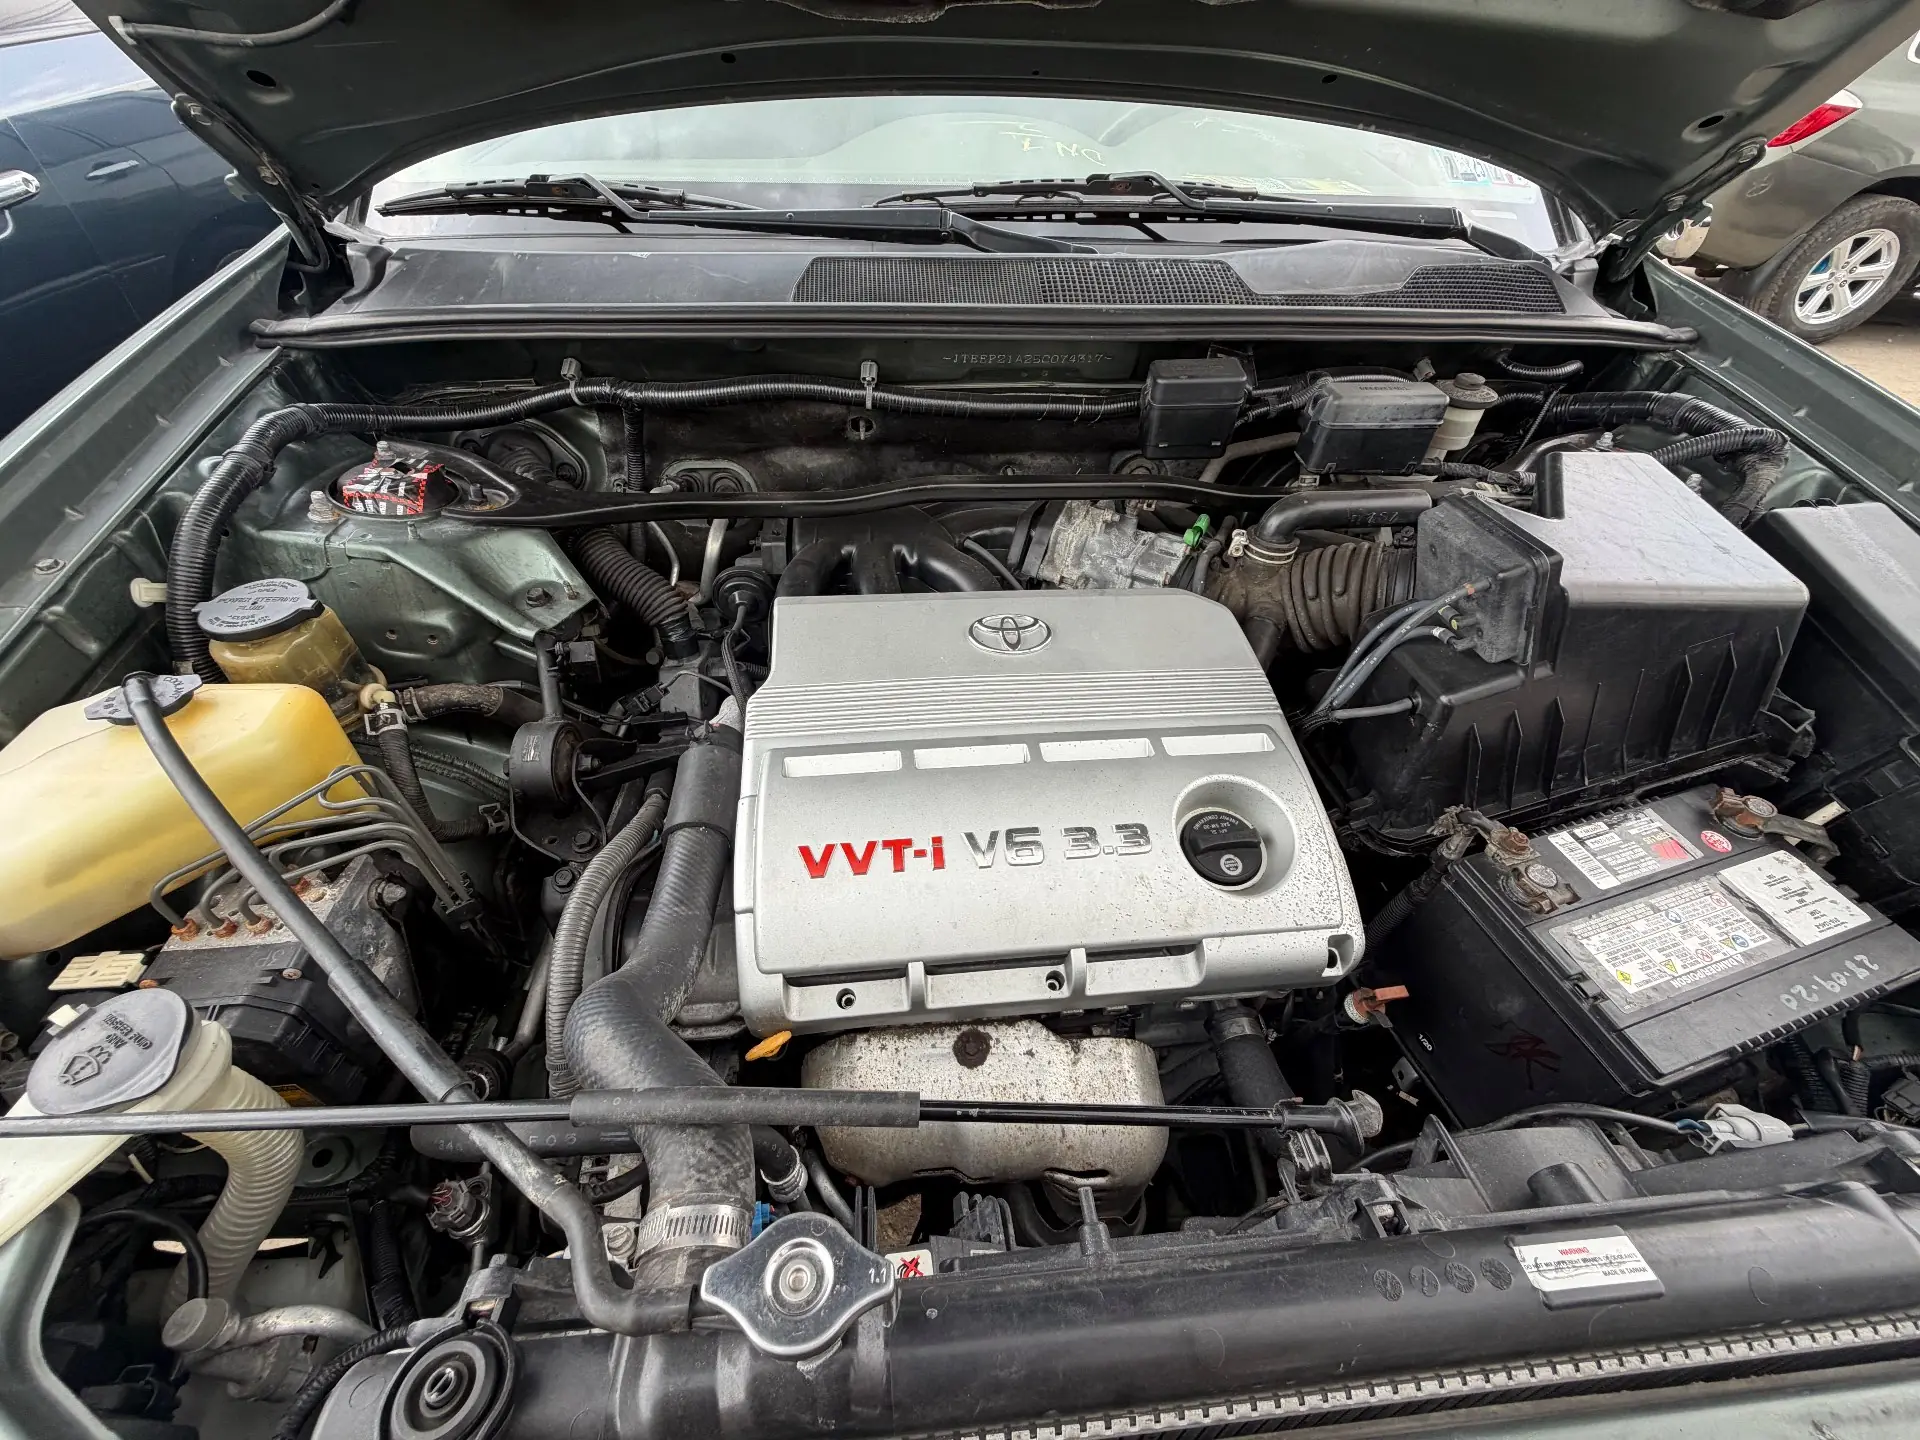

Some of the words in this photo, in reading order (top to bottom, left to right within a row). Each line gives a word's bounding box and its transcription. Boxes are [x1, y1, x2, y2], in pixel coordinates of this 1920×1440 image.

[797, 835, 947, 879] VVT-i
[960, 826, 1045, 870] V6
[1060, 823, 1153, 861] 3.3
[1558, 1246, 1589, 1256] WARNING
[868, 1267, 887, 1284] 1.1
[1626, 1266, 1649, 1275] TAIWAN
